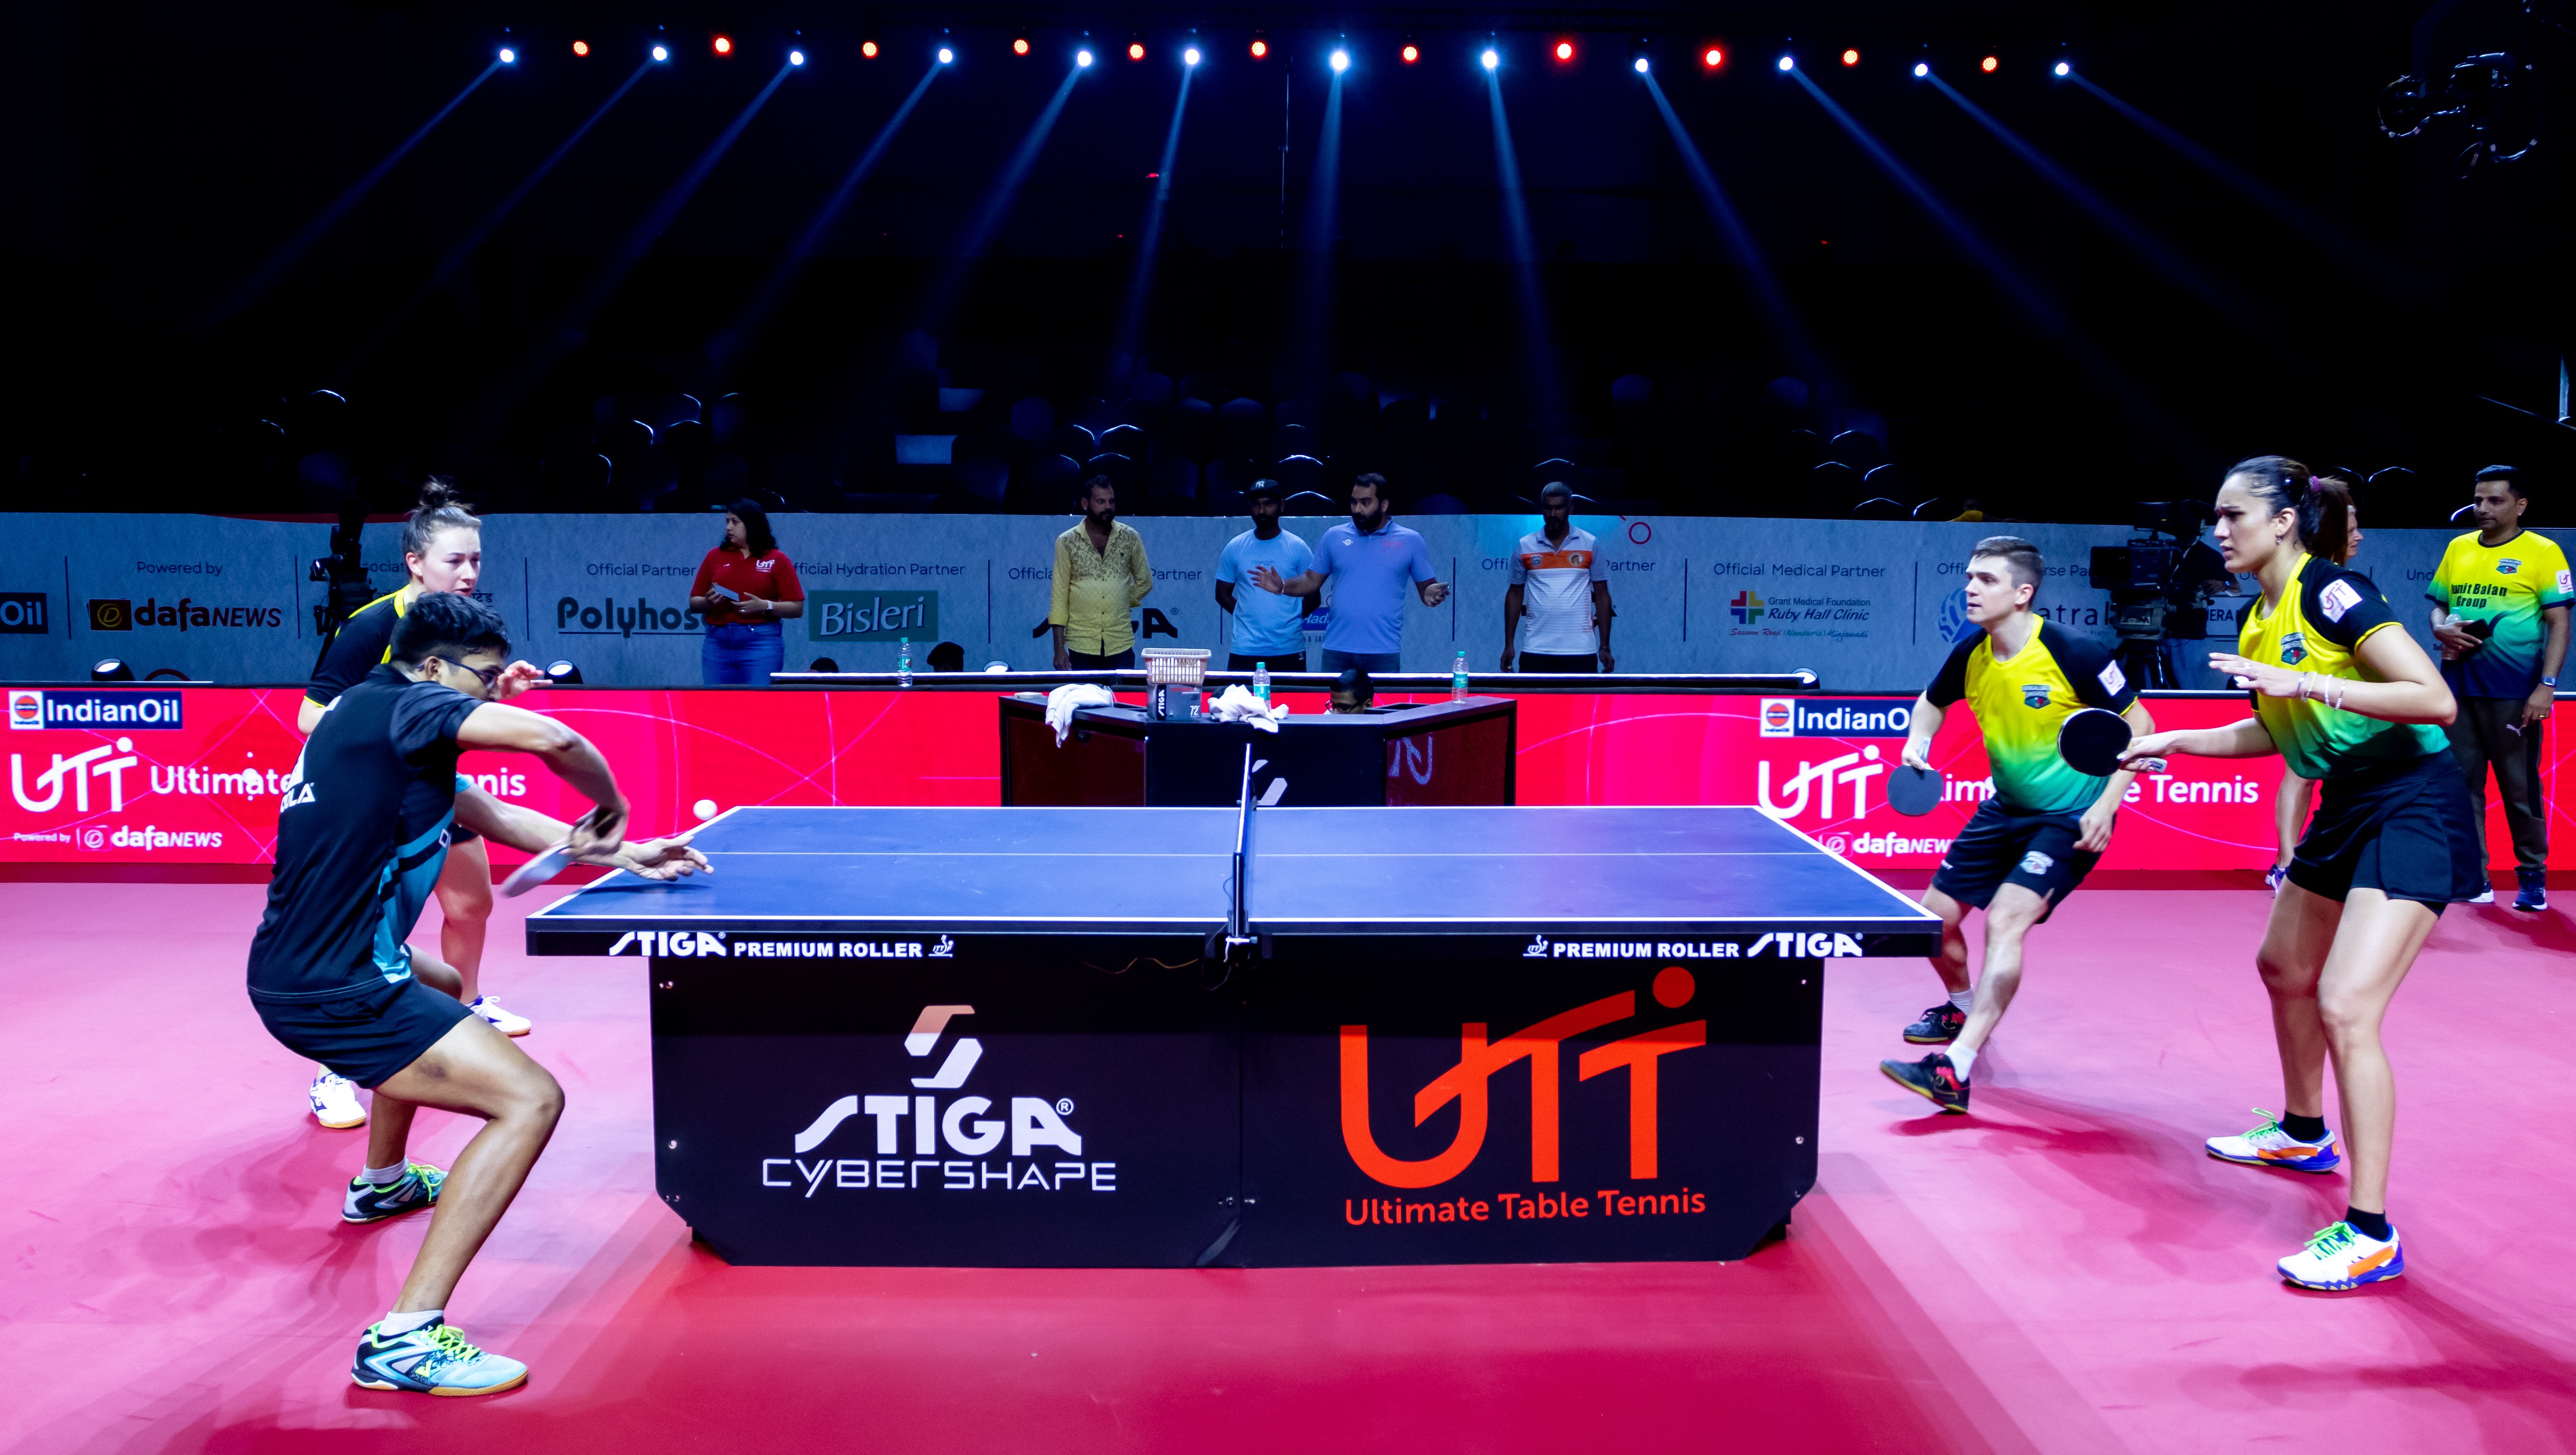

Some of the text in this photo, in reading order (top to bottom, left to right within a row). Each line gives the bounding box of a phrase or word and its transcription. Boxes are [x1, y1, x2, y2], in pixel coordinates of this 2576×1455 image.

[137, 561, 223, 576] Powered by
[586, 563, 697, 576] Official Partner
[793, 562, 965, 577] fficial Hydration Partner
[1008, 567, 1054, 580] Officia
[1713, 563, 1886, 577] Official Medical Partner
[1768, 597, 1870, 606] Grant Medical Foundation
[2456, 595, 2487, 609] Group
[2473, 583, 2507, 597] Balan
[134, 598, 282, 632] dafaNEWS
[557, 596, 706, 638] Polyhos
[819, 596, 925, 636] Bisleri
[1768, 608, 1870, 622] Ruby Hall Clinic
[47, 699, 178, 722] IndianOil
[1798, 707, 1910, 730] IndianO
[11, 737, 138, 812] UTT
[1758, 744, 1884, 820] UTT
[2148, 774, 2259, 804] Tennis
[13, 832, 71, 844] Powered by
[111, 824, 223, 851] dafaNEWS
[1853, 832, 1952, 858] dafaNEW
[608, 931, 727, 957] STIGA
[734, 942, 833, 957] PREMIUM
[839, 942, 922, 957] ROLLER
[1553, 943, 1652, 958] PREMIUM
[1657, 943, 1740, 958] ROLLER
[1748, 932, 1863, 958] STIGA
[1340, 966, 1707, 1189] UTT
[794, 1095, 1082, 1156] STIGA
[762, 1158, 1116, 1198] CYBERSHAPE
[1346, 1187, 1706, 1226] Ultimate Table Tennis
